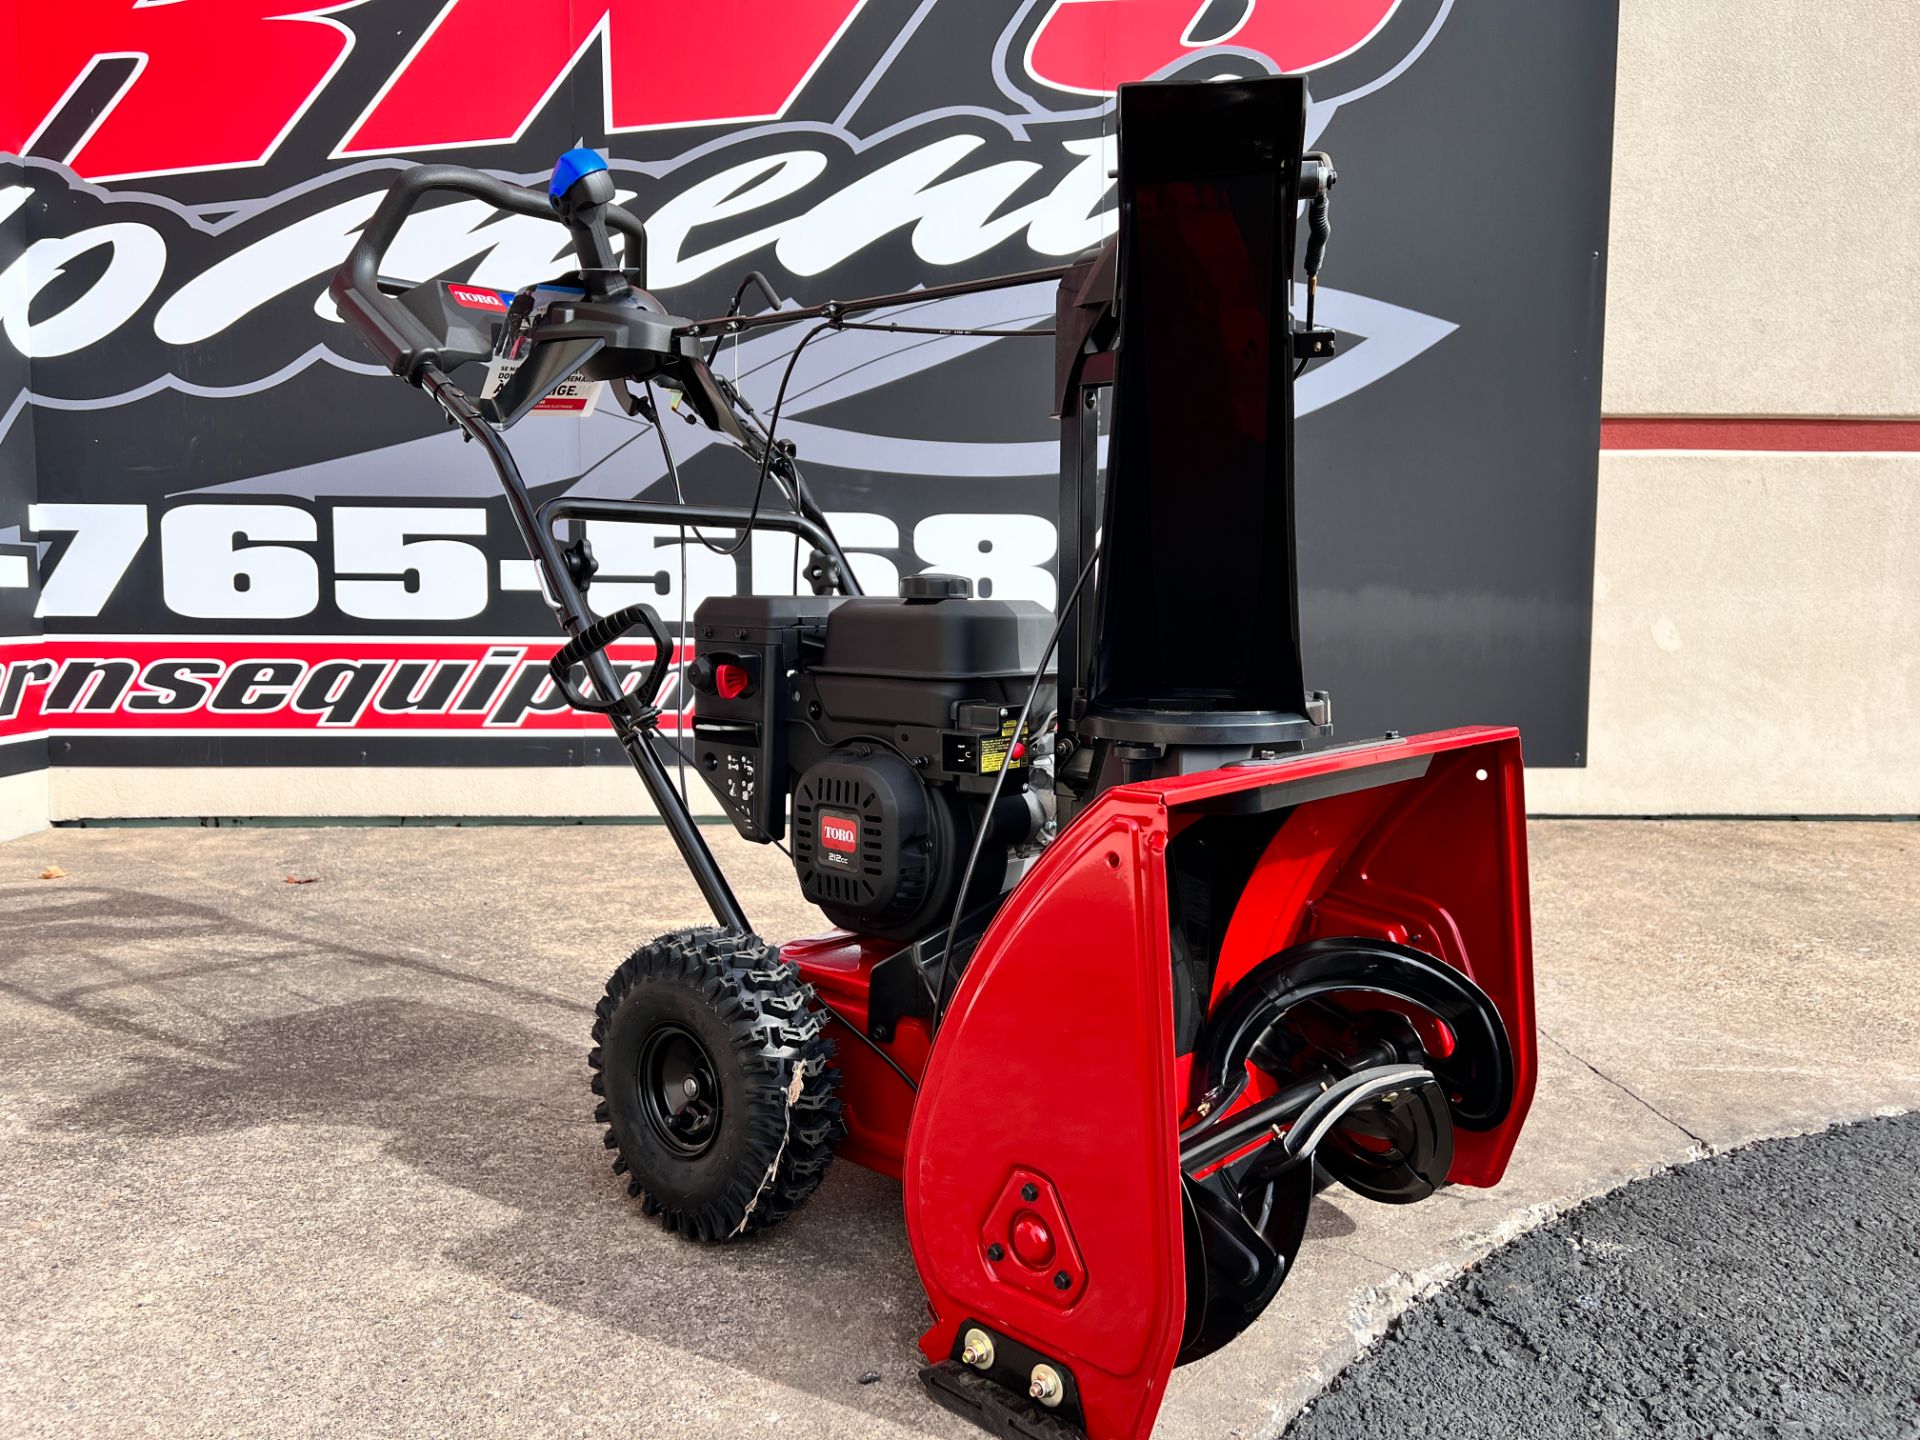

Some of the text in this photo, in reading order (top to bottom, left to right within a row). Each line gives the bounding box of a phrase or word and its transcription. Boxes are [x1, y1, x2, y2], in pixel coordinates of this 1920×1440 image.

[454, 291, 502, 306] TORO
[824, 826, 854, 843] TORO
[828, 853, 848, 864] 212cc
